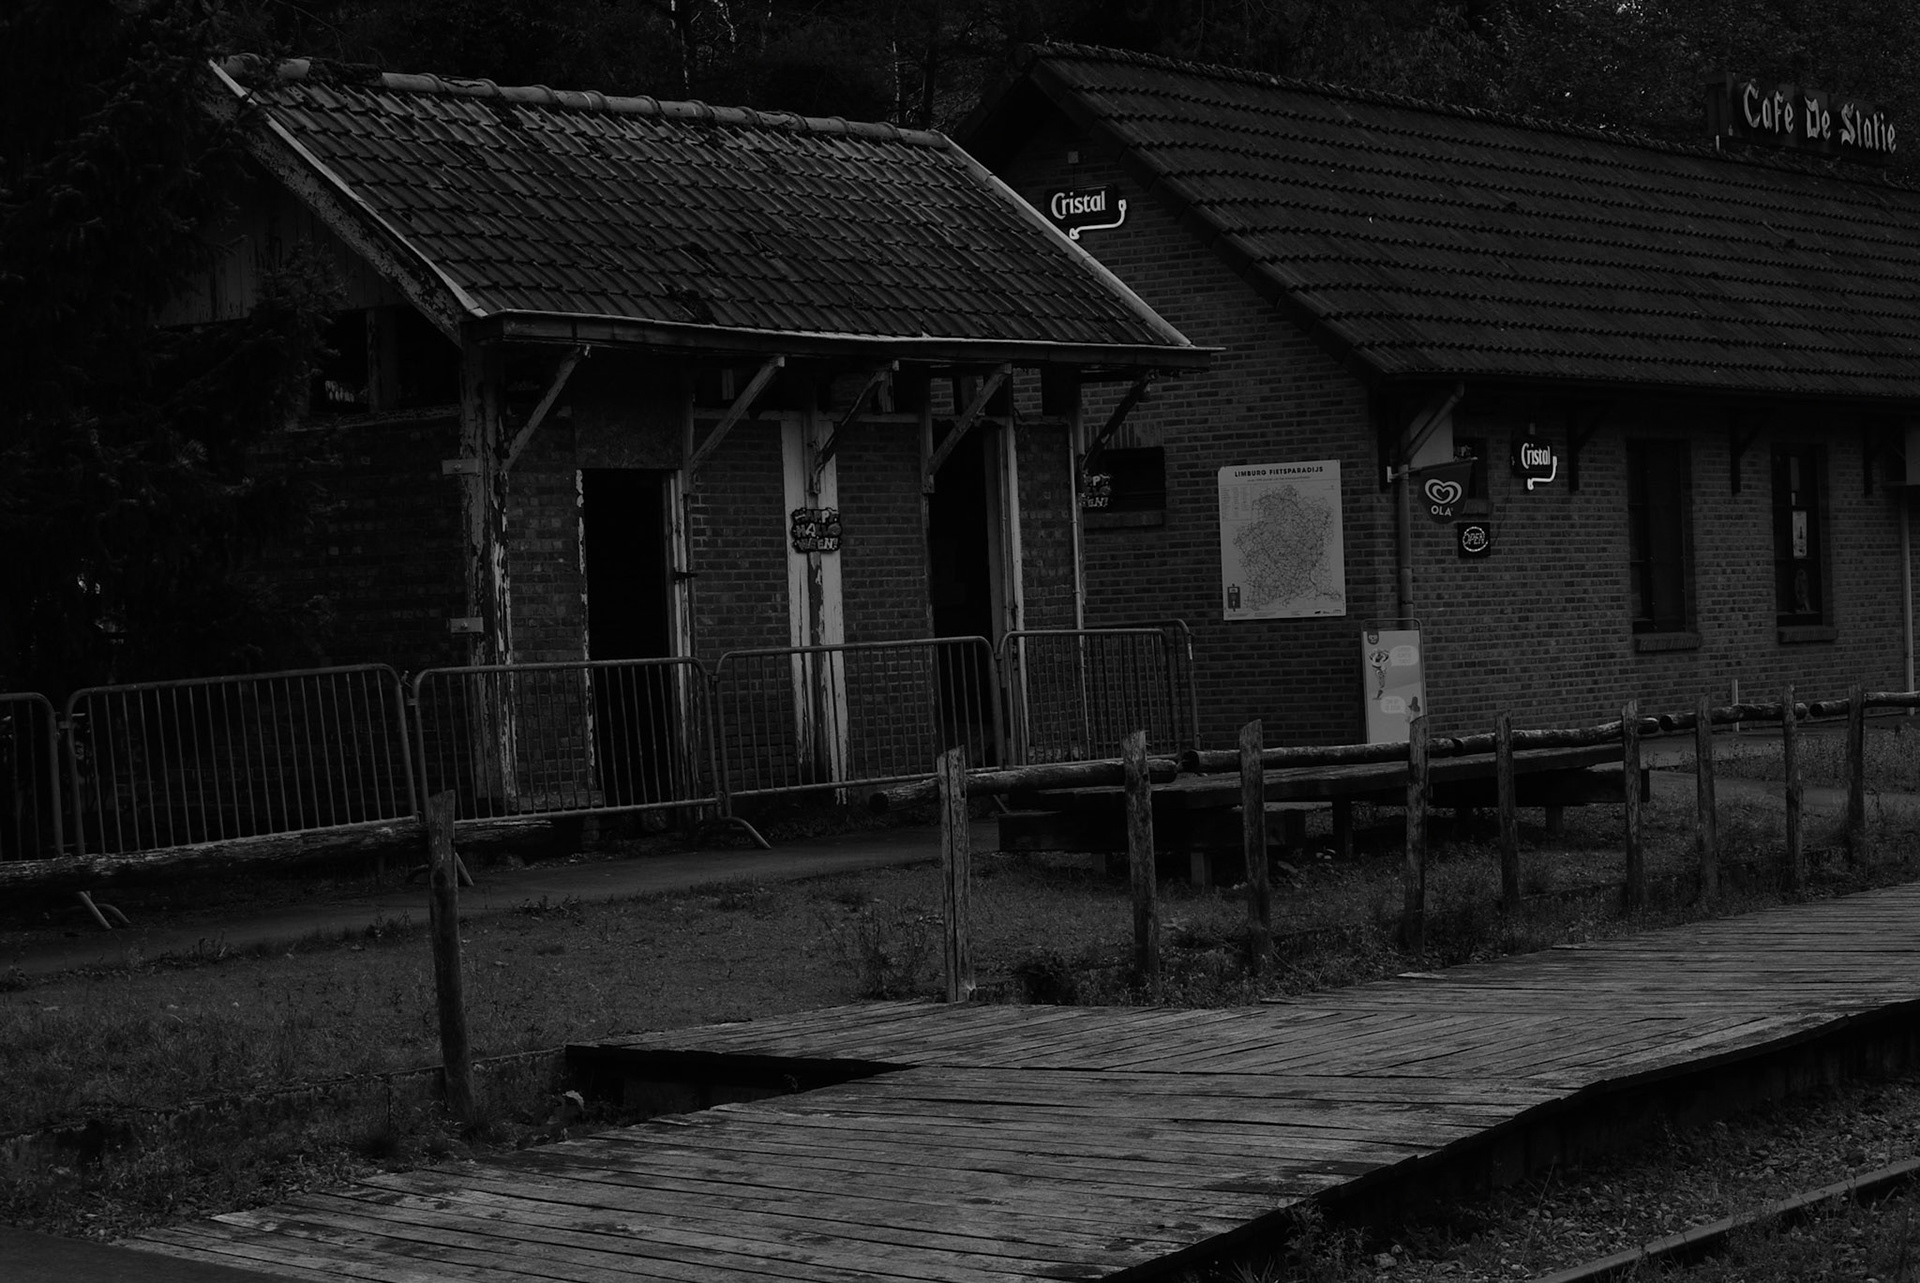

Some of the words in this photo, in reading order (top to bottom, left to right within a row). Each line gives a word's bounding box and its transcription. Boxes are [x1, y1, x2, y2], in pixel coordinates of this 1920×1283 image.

[1743, 78, 1794, 134] Cafe
[1804, 96, 1831, 141] De
[1051, 190, 1106, 219] Cristal
[1521, 442, 1551, 469] Cristal
[1234, 469, 1267, 477] LIMBURG
[1269, 466, 1324, 475] FIETSPARADIJS
[1462, 532, 1485, 545] OPEN
